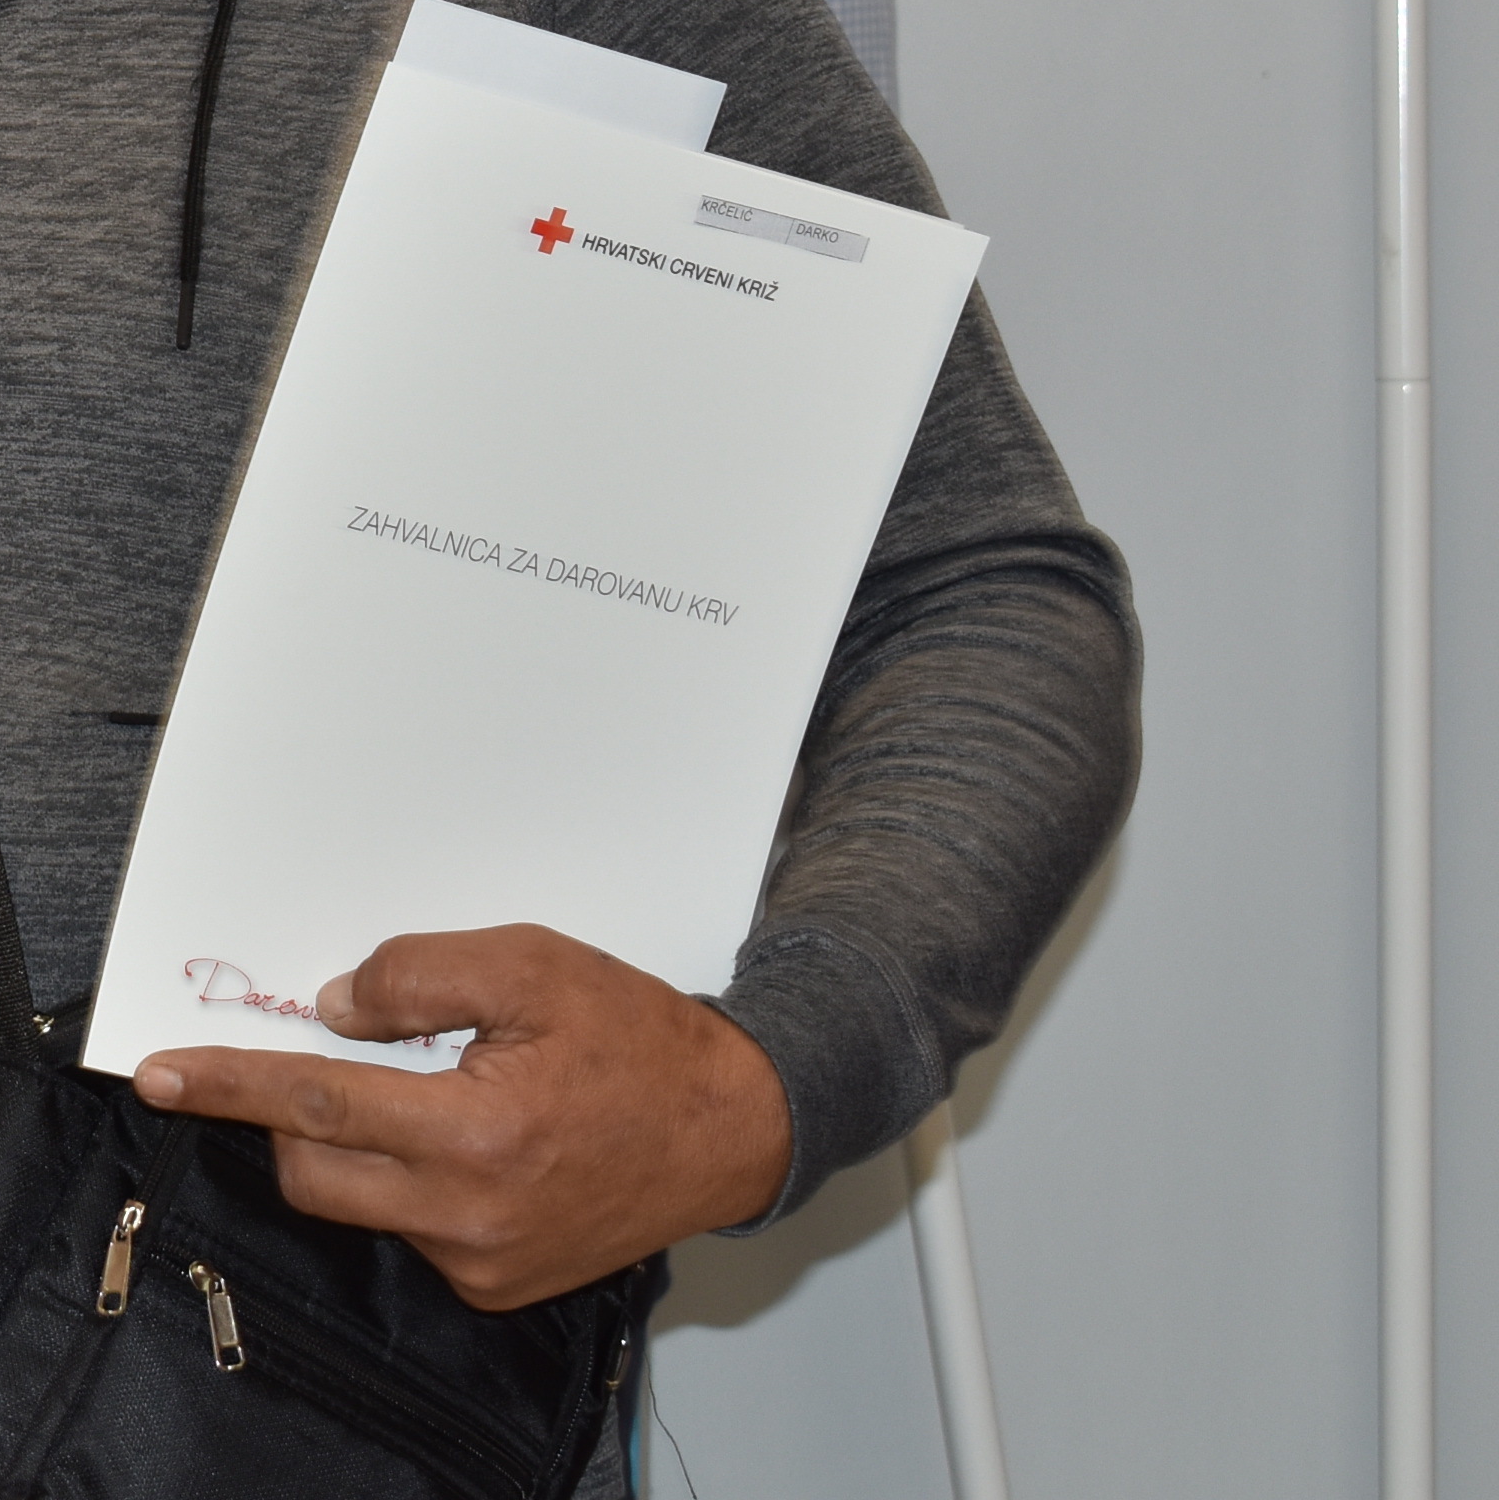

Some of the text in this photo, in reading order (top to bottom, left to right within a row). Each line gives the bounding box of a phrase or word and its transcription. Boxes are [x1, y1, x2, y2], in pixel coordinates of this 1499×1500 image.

[581, 232, 779, 301] HRVATSKI CRVENI KRIŽ
[796, 223, 839, 244] DARKO
[347, 505, 740, 627] ZAHVALNICA ZA DAROVANU KRV
